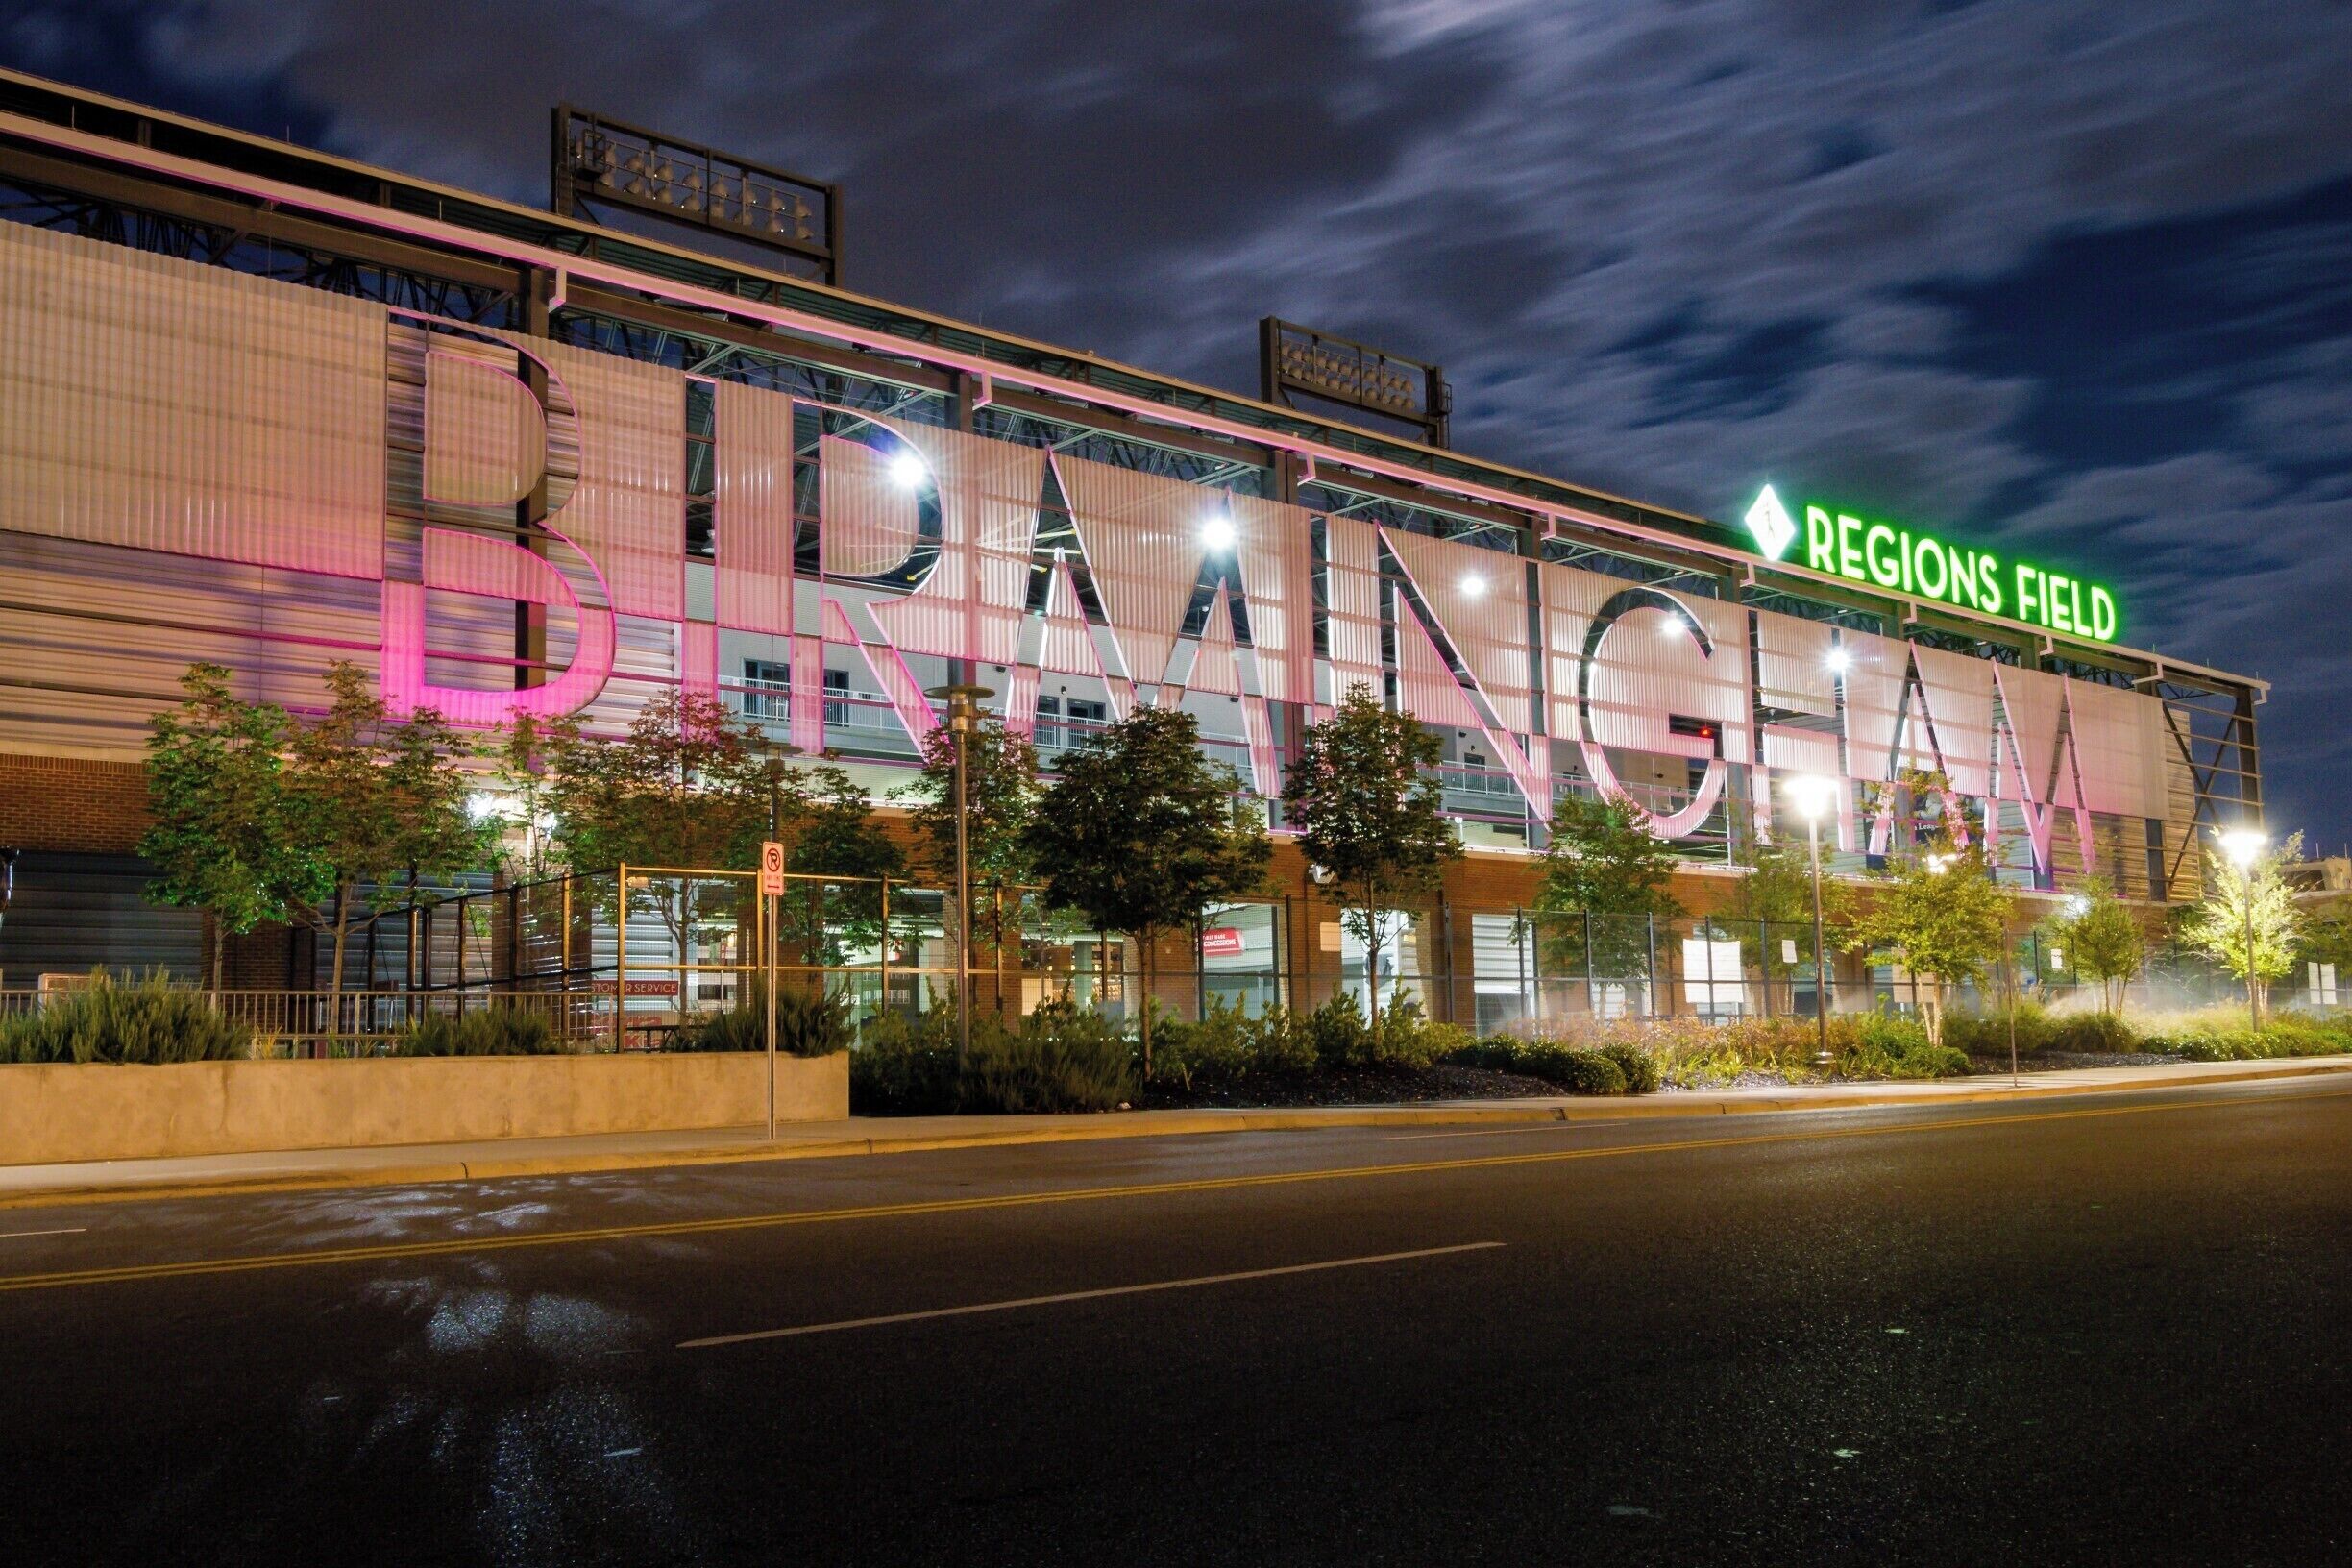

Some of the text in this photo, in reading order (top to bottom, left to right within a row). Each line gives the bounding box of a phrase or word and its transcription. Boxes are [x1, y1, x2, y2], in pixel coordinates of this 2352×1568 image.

[380, 306, 2095, 875] BIRMINGHAM
[1807, 504, 2117, 641] REGIONS FIELD
[634, 983, 676, 992] SERVICE
